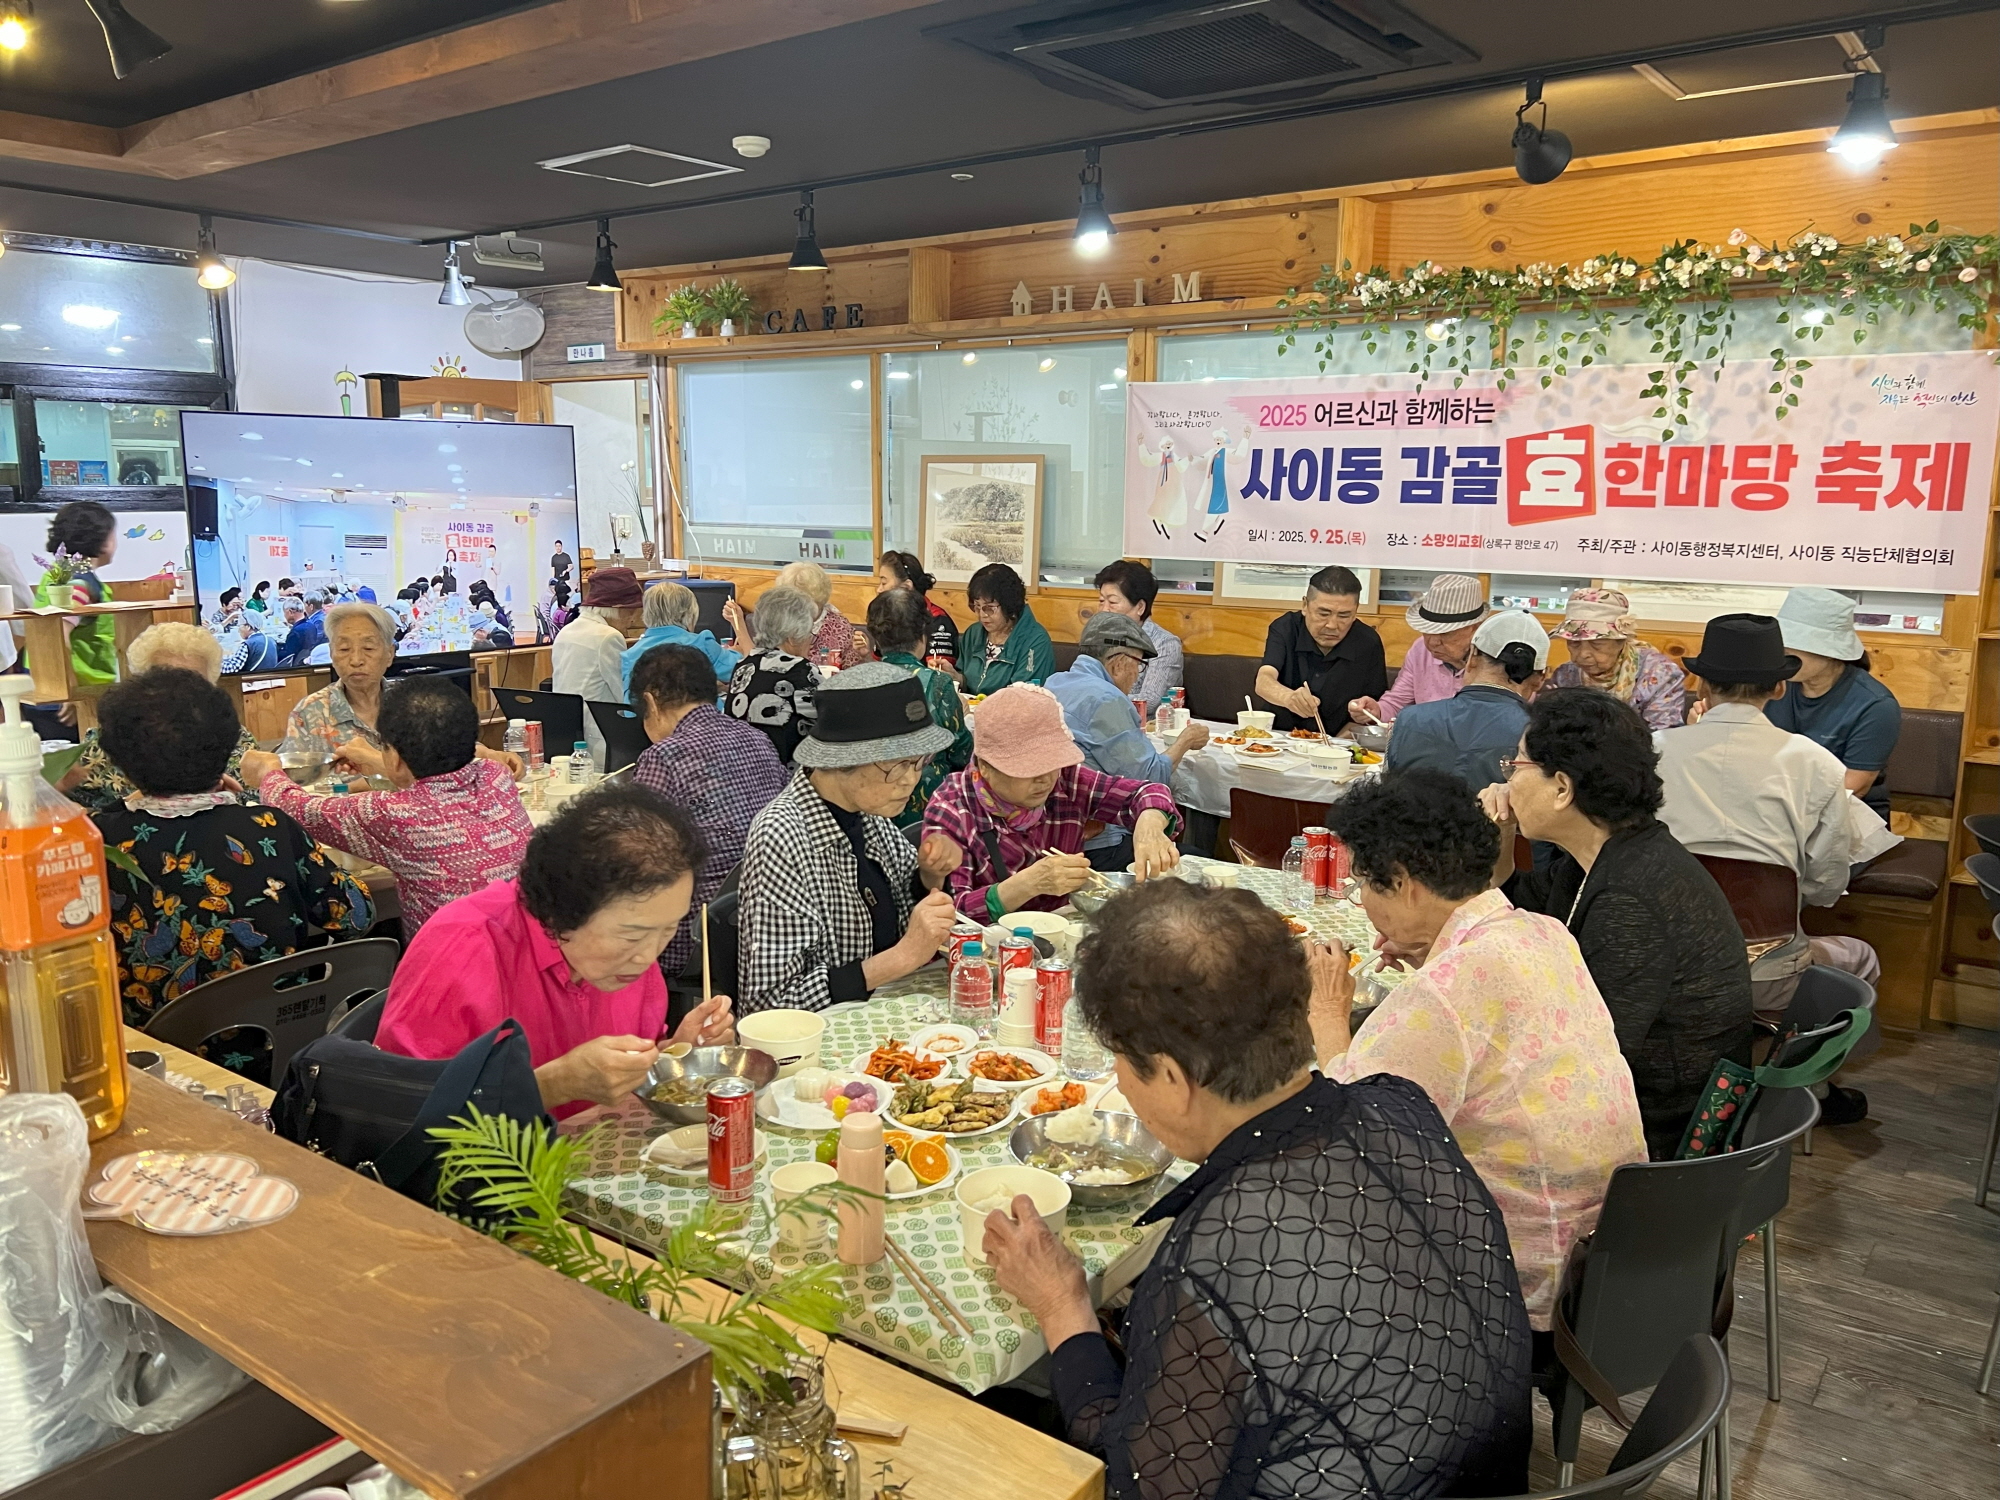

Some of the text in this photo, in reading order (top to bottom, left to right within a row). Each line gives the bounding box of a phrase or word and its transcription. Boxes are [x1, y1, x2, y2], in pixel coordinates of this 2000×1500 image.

[1050, 271, 1202, 313] HAIM
[763, 303, 864, 334] CAFE
[1871, 374, 1902, 394] 시민과
[1879, 391, 1979, 411] 자유로운 혁신도시 안산
[1259, 397, 1496, 427] 2025 어르신과 함께하는
[1239, 432, 1971, 511] 사이동 감골 효 한마당 축제
[448, 522, 493, 533] 사이동 감골
[1248, 529, 1268, 542] 일시
[1278, 530, 1307, 543] 2025.
[461, 536, 494, 548] 한마당
[713, 538, 756, 555] HAIM
[799, 542, 845, 559] HAIM
[1386, 533, 1409, 546] 장소
[1514, 539, 1541, 550] 평안로
[1543, 540, 1558, 551] 47)
[1577, 538, 1636, 554] 주최/주관
[1651, 540, 1784, 560] 사이동행정복지센터,
[1788, 545, 1836, 562] 사이동
[1841, 546, 1955, 565] 직능단체협의회
